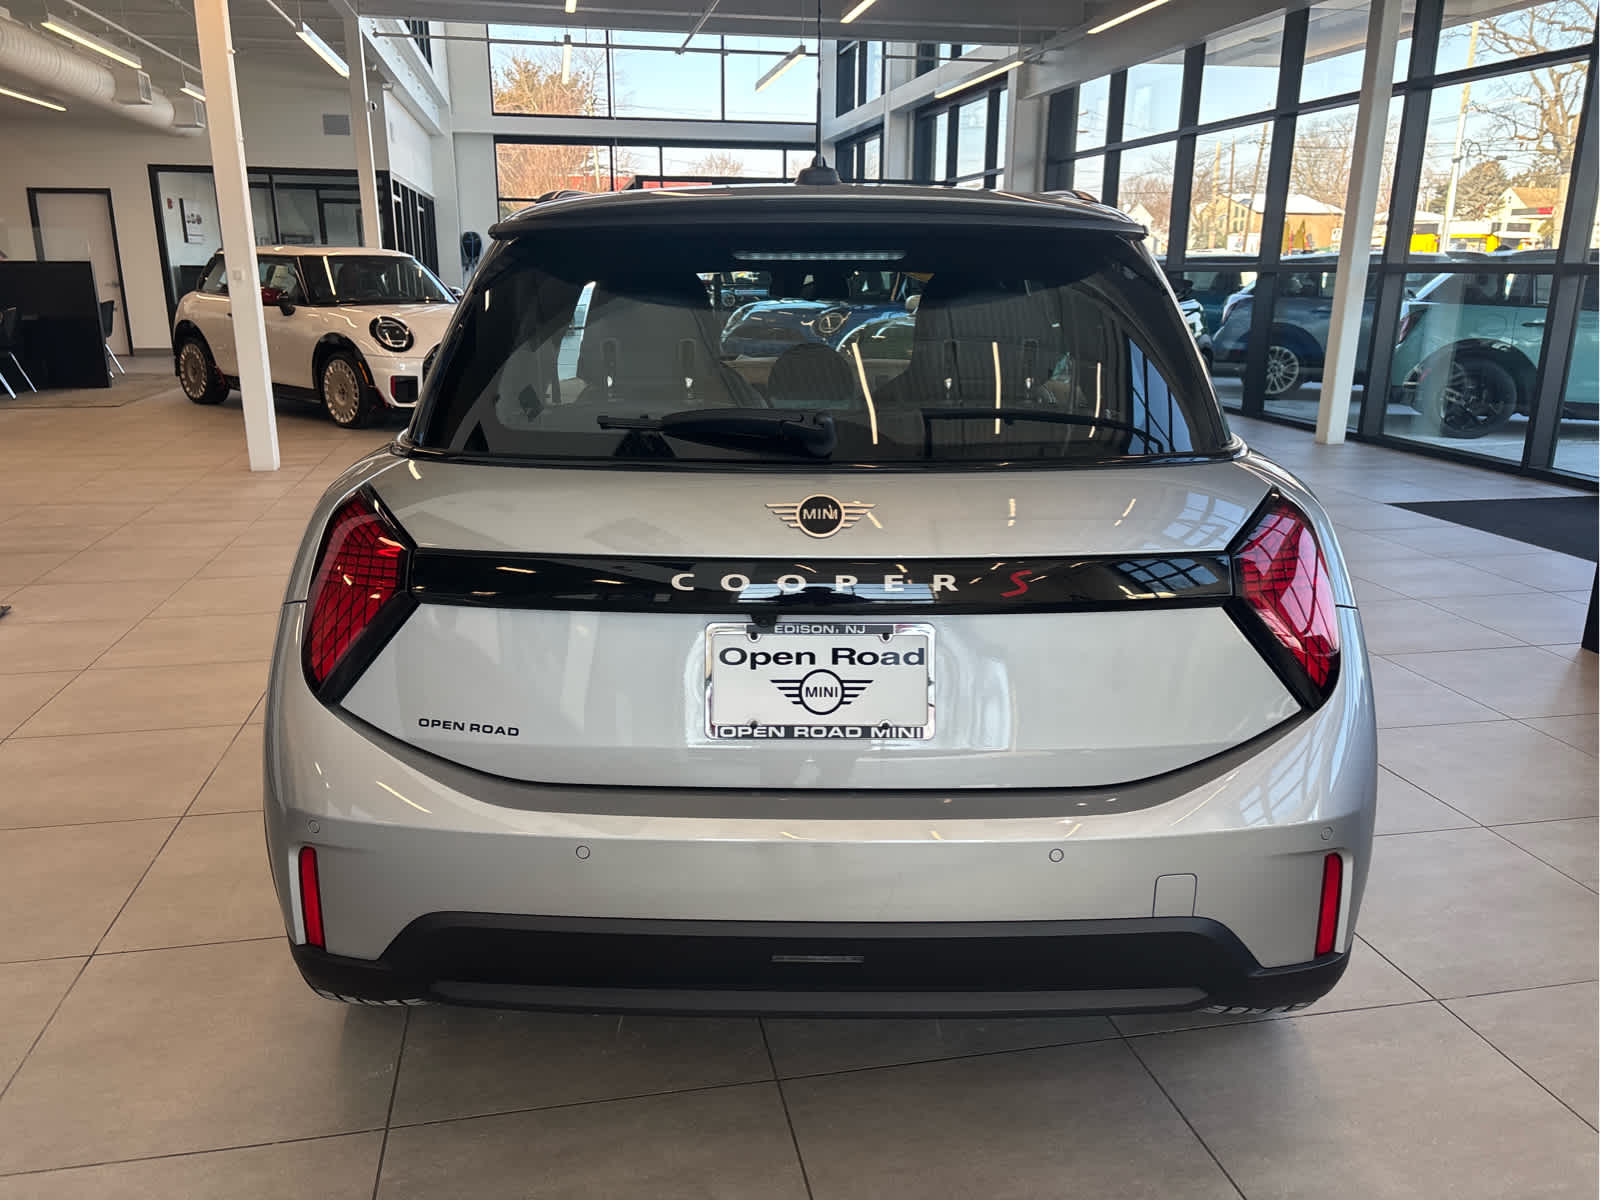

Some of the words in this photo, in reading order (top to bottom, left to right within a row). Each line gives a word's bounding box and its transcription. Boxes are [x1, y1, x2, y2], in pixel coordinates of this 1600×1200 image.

[802, 509, 839, 520] MINI
[671, 573, 959, 592] COOPER
[1000, 570, 1032, 598] S
[845, 625, 866, 634] NJ
[719, 647, 816, 670] Open
[831, 647, 925, 666] Road
[805, 686, 839, 698] MINI
[418, 718, 465, 731] OPEN
[469, 723, 520, 737] ROAD
[719, 726, 785, 738] OPEN
[793, 726, 862, 738] ROAD
[871, 726, 922, 737] MINI
